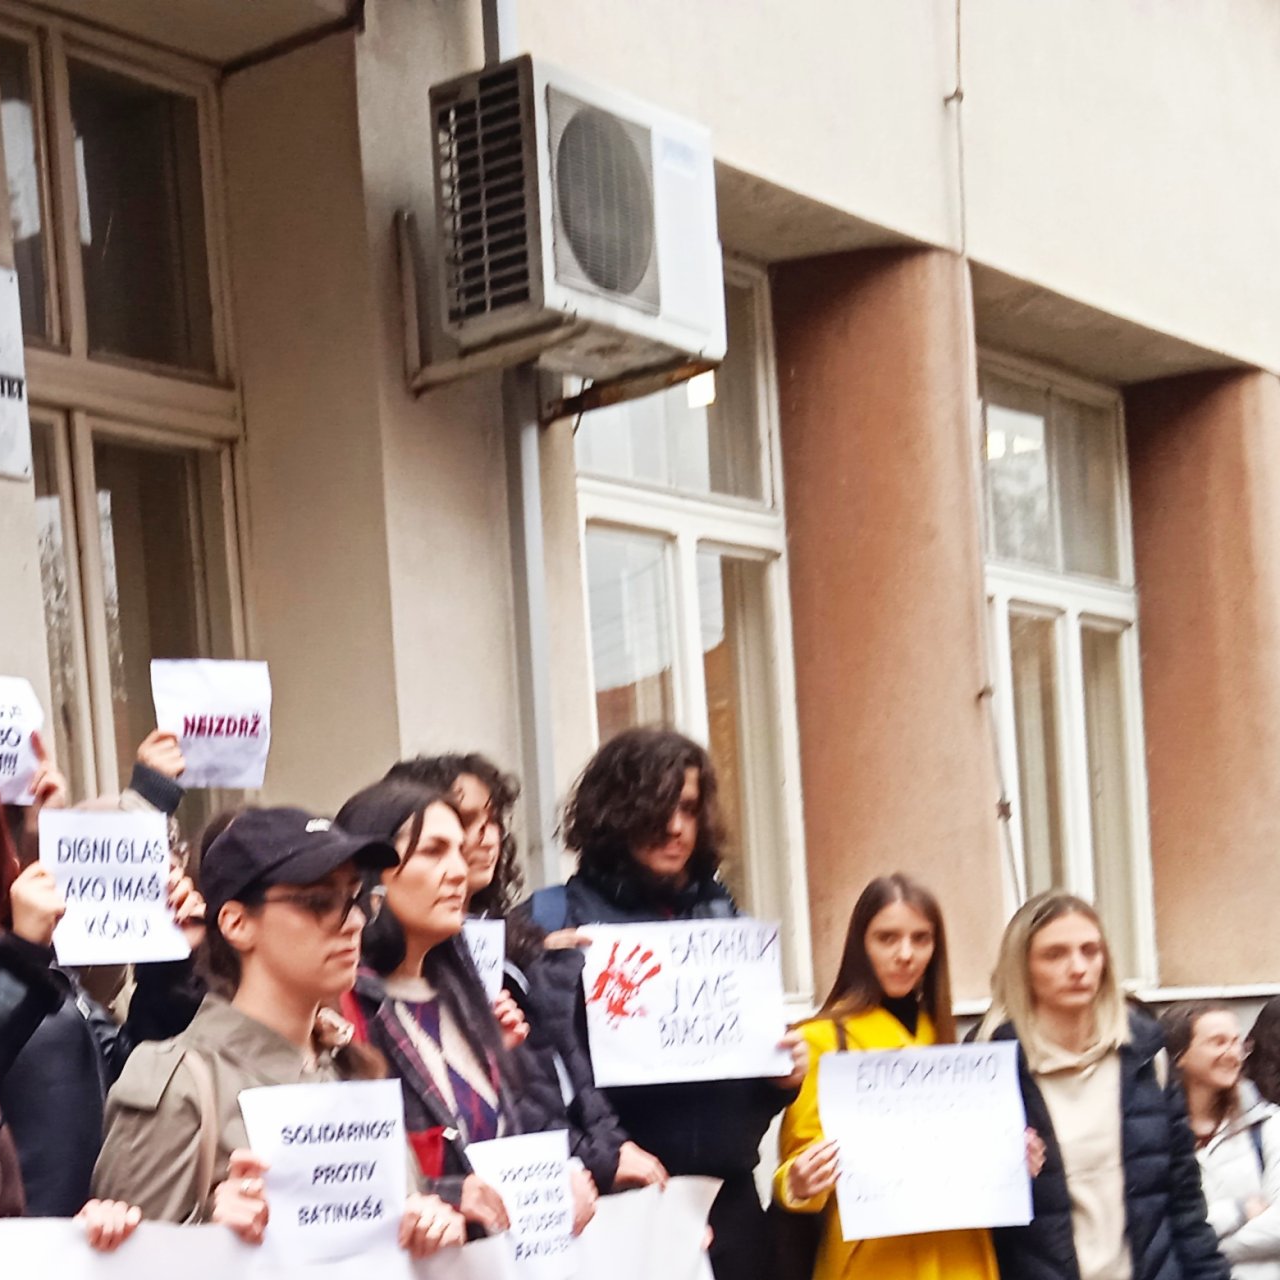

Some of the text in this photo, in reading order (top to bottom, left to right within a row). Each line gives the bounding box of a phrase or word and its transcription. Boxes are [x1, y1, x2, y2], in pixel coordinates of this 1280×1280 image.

[57, 837, 165, 864] DIGNI GLAS
[65, 871, 161, 903] AKO IMAŠ
[281, 1119, 397, 1145] SOLIDARNOST
[311, 1160, 377, 1185] PROTIV
[297, 1195, 385, 1227] BATINAŠA
